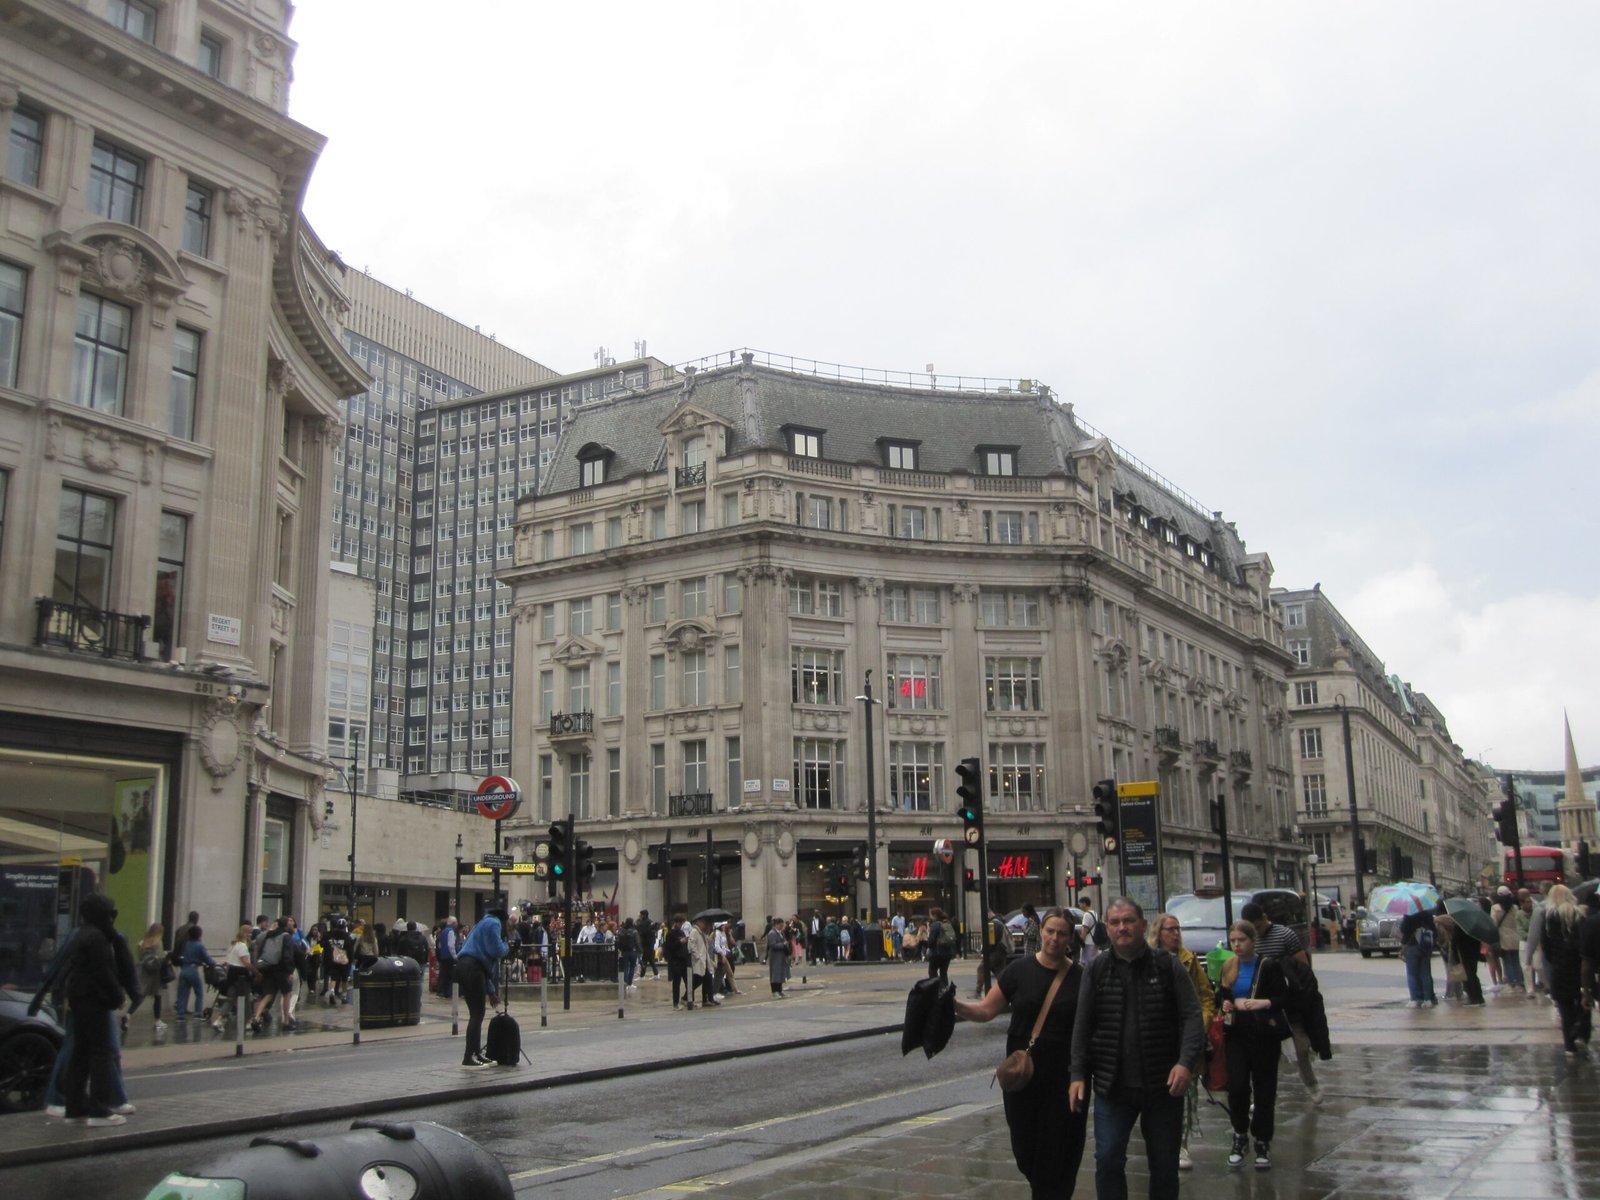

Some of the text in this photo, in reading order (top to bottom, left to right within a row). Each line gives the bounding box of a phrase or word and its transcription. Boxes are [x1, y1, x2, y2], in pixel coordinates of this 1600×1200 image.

[211, 616, 231, 626] REGENT
[211, 623, 230, 632] STREET
[195, 682, 213, 694] 251
[473, 792, 516, 802] UNDERGROUND
[998, 856, 1029, 878] H&M
